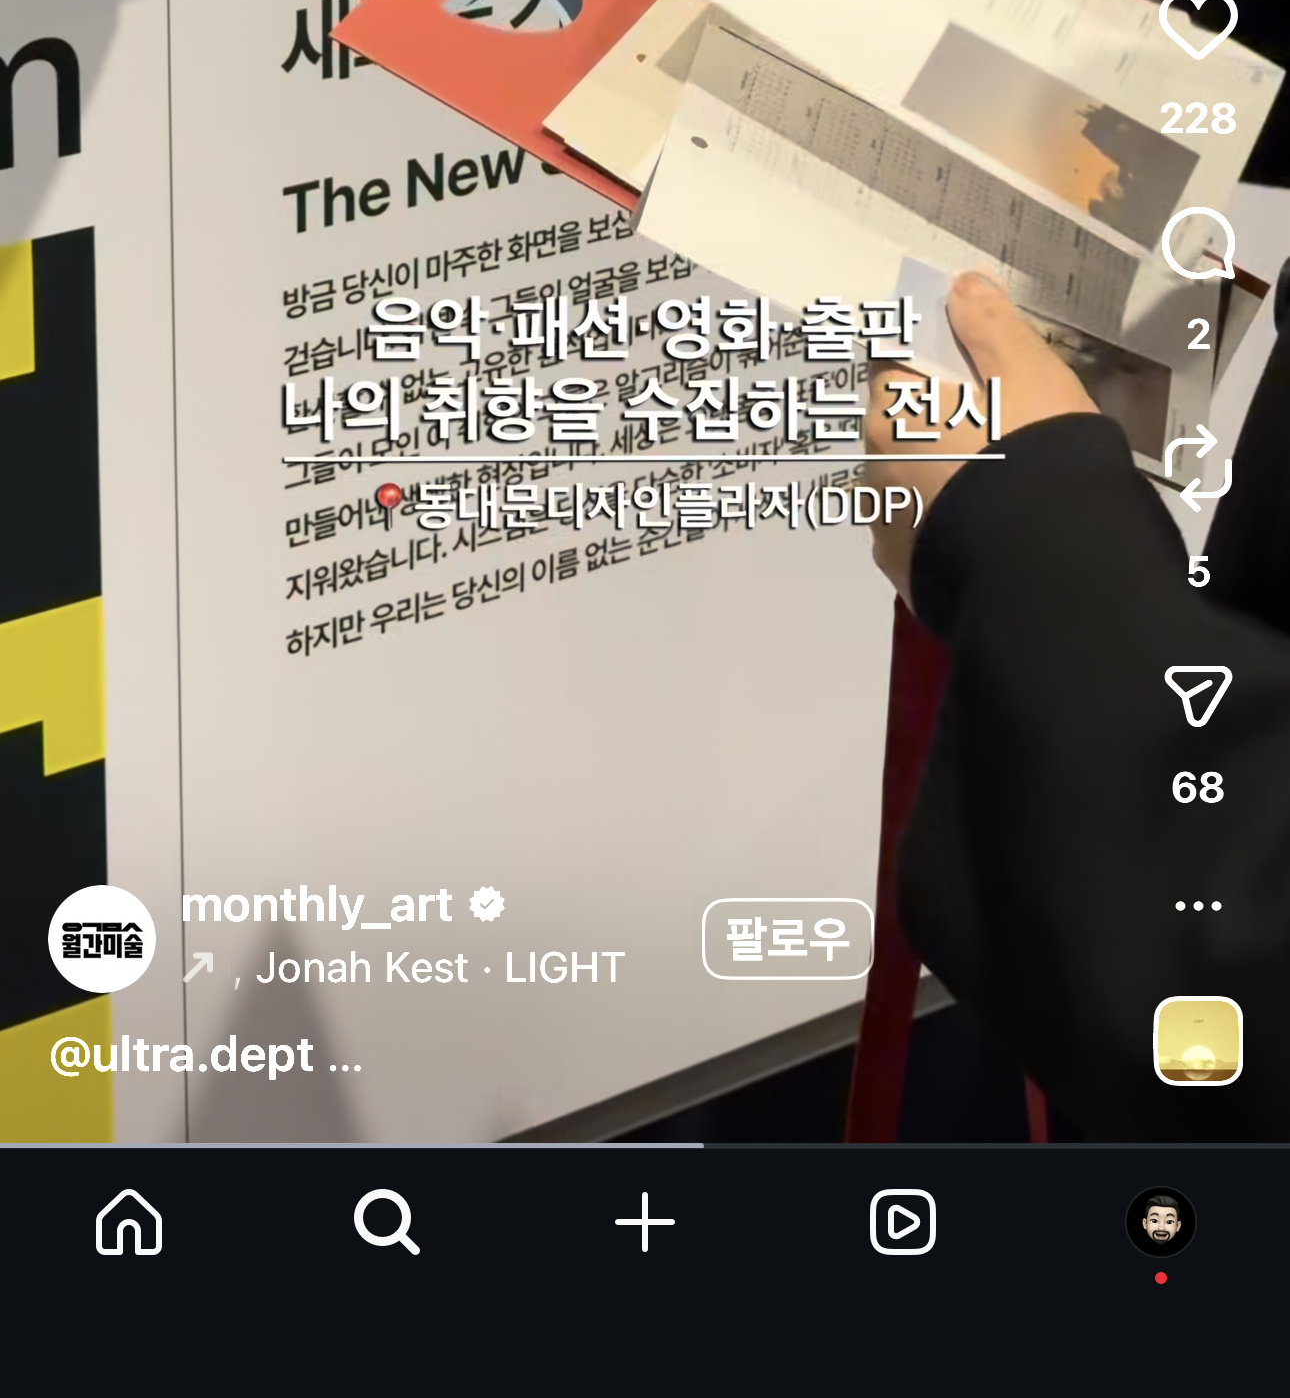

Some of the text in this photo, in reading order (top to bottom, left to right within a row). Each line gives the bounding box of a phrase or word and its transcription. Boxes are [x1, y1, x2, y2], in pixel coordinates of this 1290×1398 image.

[282, 146, 526, 234] The New
[283, 279, 336, 319] 방금
[342, 258, 419, 304] 당신이
[426, 238, 502, 282] 마주한
[508, 220, 582, 263] 화면을
[569, 261, 641, 304] 얼굴을
[286, 533, 448, 600] 지워왔습니다.
[286, 611, 365, 656] 하지만
[370, 591, 447, 634] 우리는
[452, 562, 525, 611] 당신의
[531, 547, 580, 585] 이름
[585, 536, 632, 572] 없는
